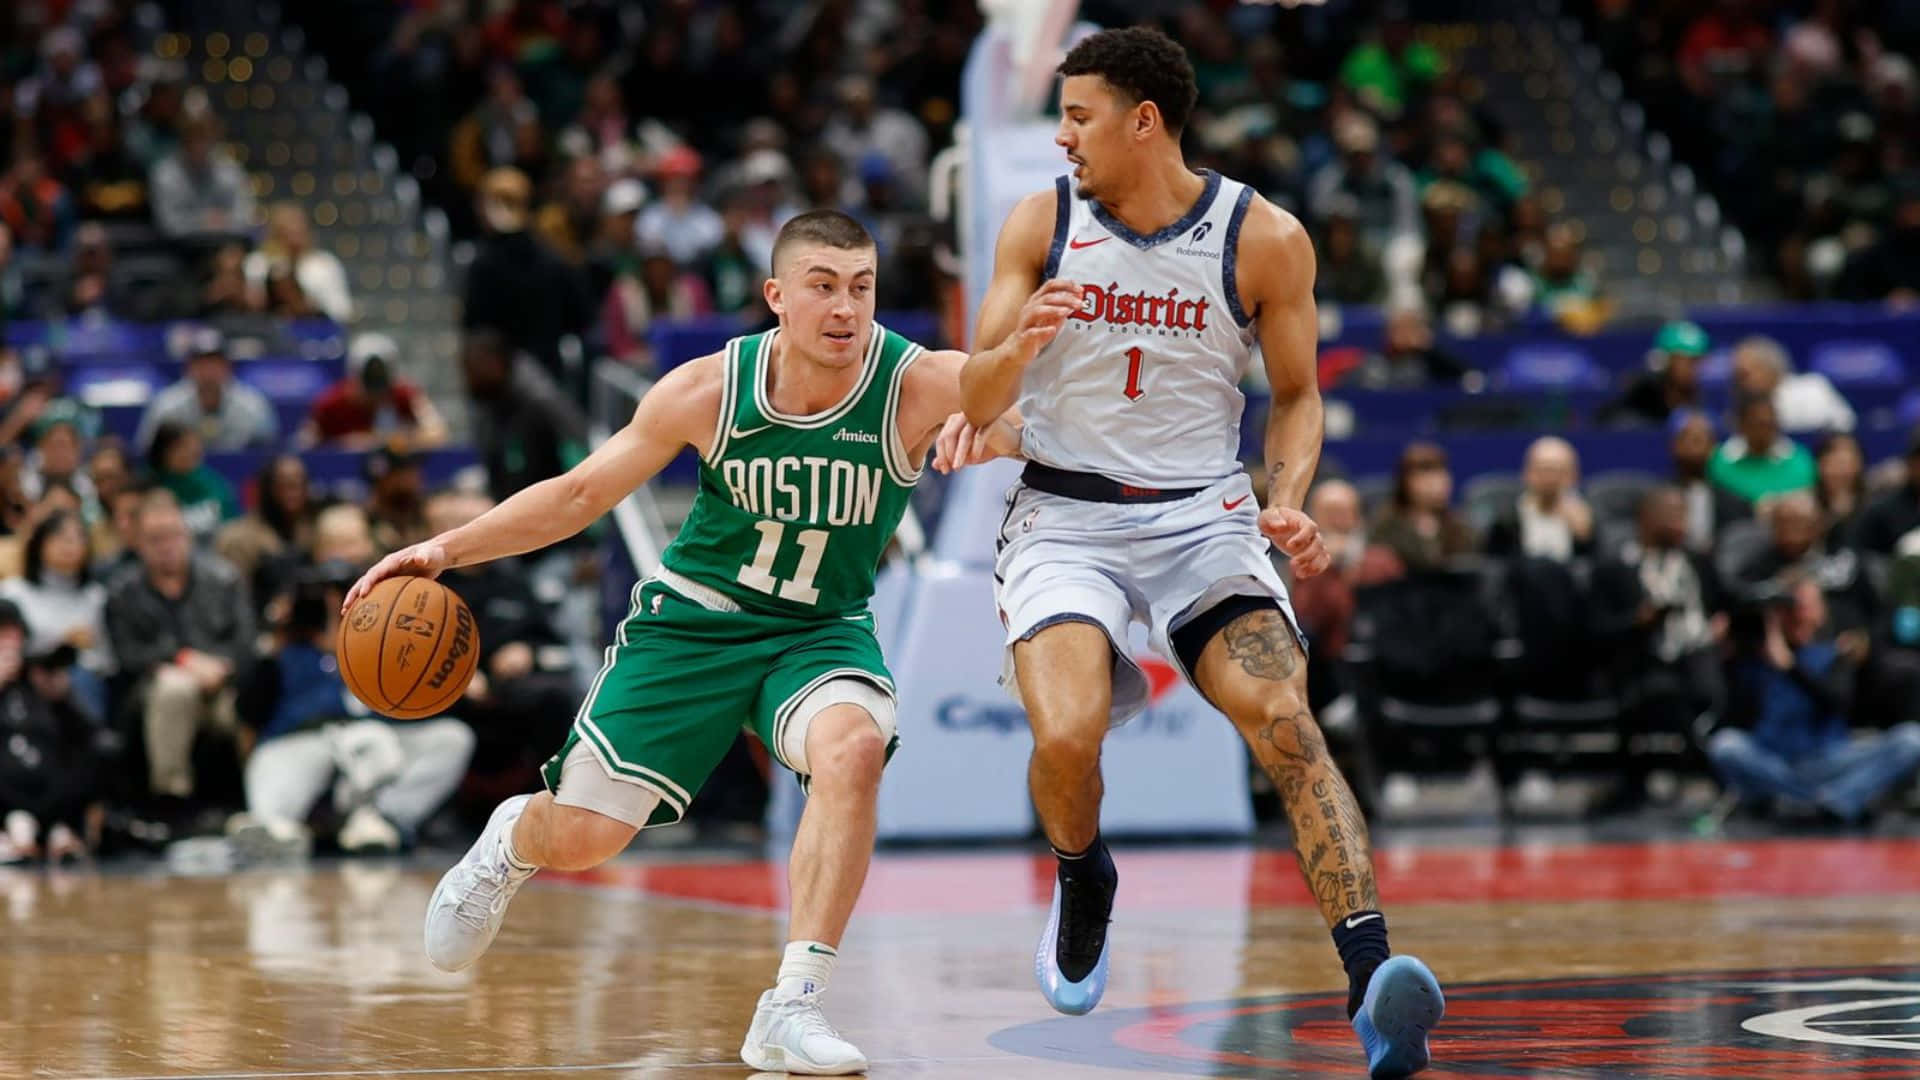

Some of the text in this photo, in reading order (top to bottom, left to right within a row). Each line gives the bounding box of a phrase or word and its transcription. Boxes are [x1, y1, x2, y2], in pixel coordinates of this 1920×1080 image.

[1176, 247, 1220, 260] Robinhood
[1067, 281, 1210, 331] District
[1074, 323, 1203, 339] OF COLUMBIA
[1123, 345, 1145, 403] 1
[832, 427, 879, 444] Amica
[722, 456, 884, 527] BOSTON
[736, 520, 831, 606] 11
[427, 604, 473, 689] Wilson
